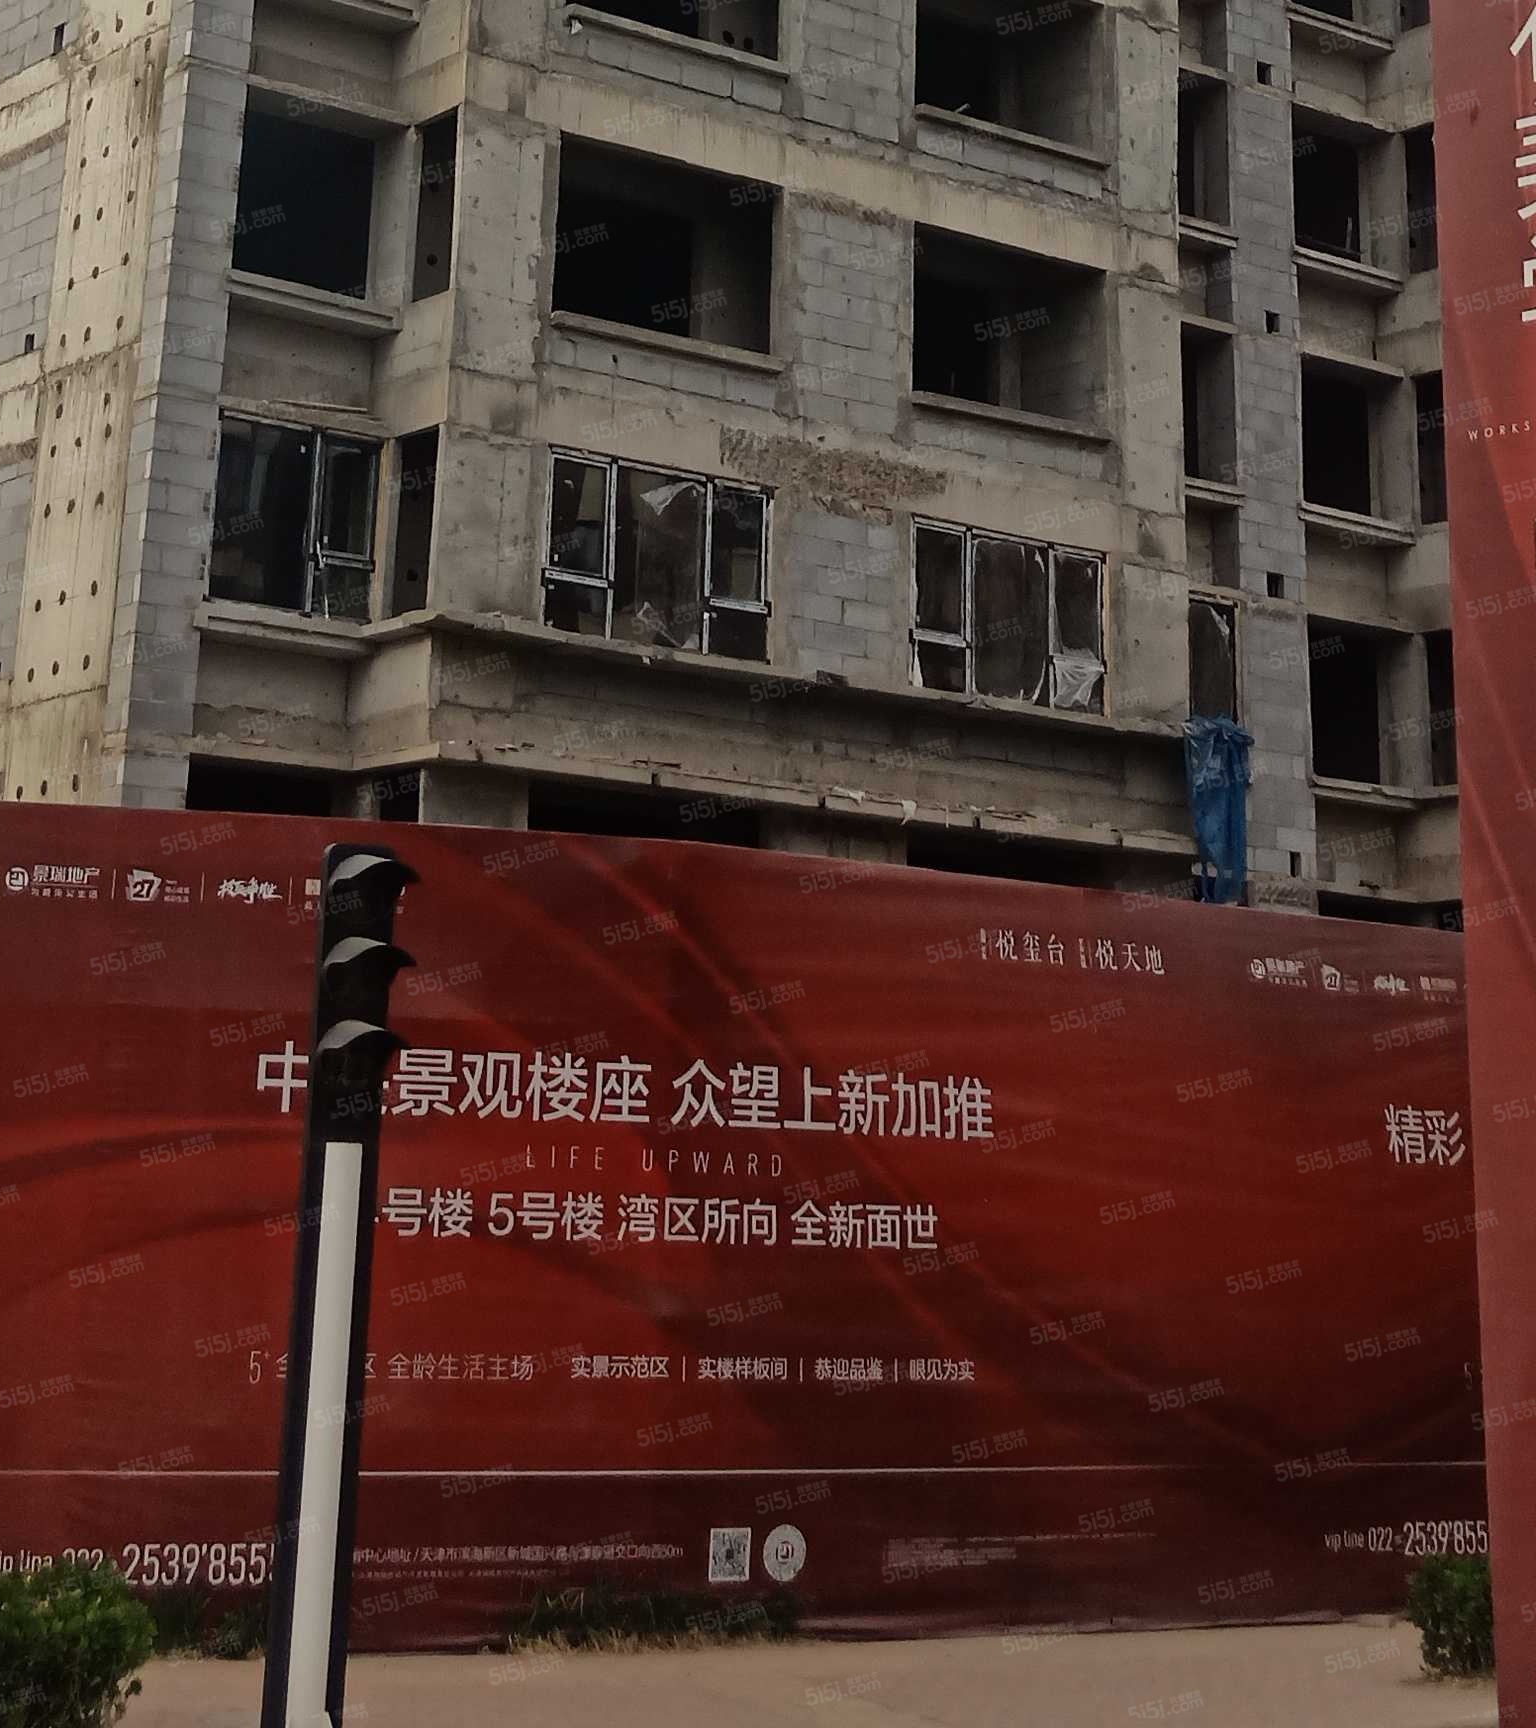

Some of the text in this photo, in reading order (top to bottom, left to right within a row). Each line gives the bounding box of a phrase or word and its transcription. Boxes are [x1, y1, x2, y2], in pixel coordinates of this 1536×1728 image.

[1467, 420, 1532, 441] WORKS
[32, 864, 101, 884] 景瑞地产
[995, 927, 1066, 967] 悦玺台
[1094, 939, 1167, 976] 悦天地
[256, 1040, 995, 1142] 中景观楼座 众望上新加推
[1384, 1103, 1467, 1167] 精彩
[525, 1144, 785, 1178] LIFE UPWARD
[374, 1189, 939, 1252] 号楼 5号楼 湾区所向 全新面世
[387, 1350, 535, 1384] 全龄生活主场
[570, 1354, 976, 1383] 实景示范区 实楼样板间 恭迎品鉴 眼见为实
[1402, 1519, 1489, 1557] 2539'855
